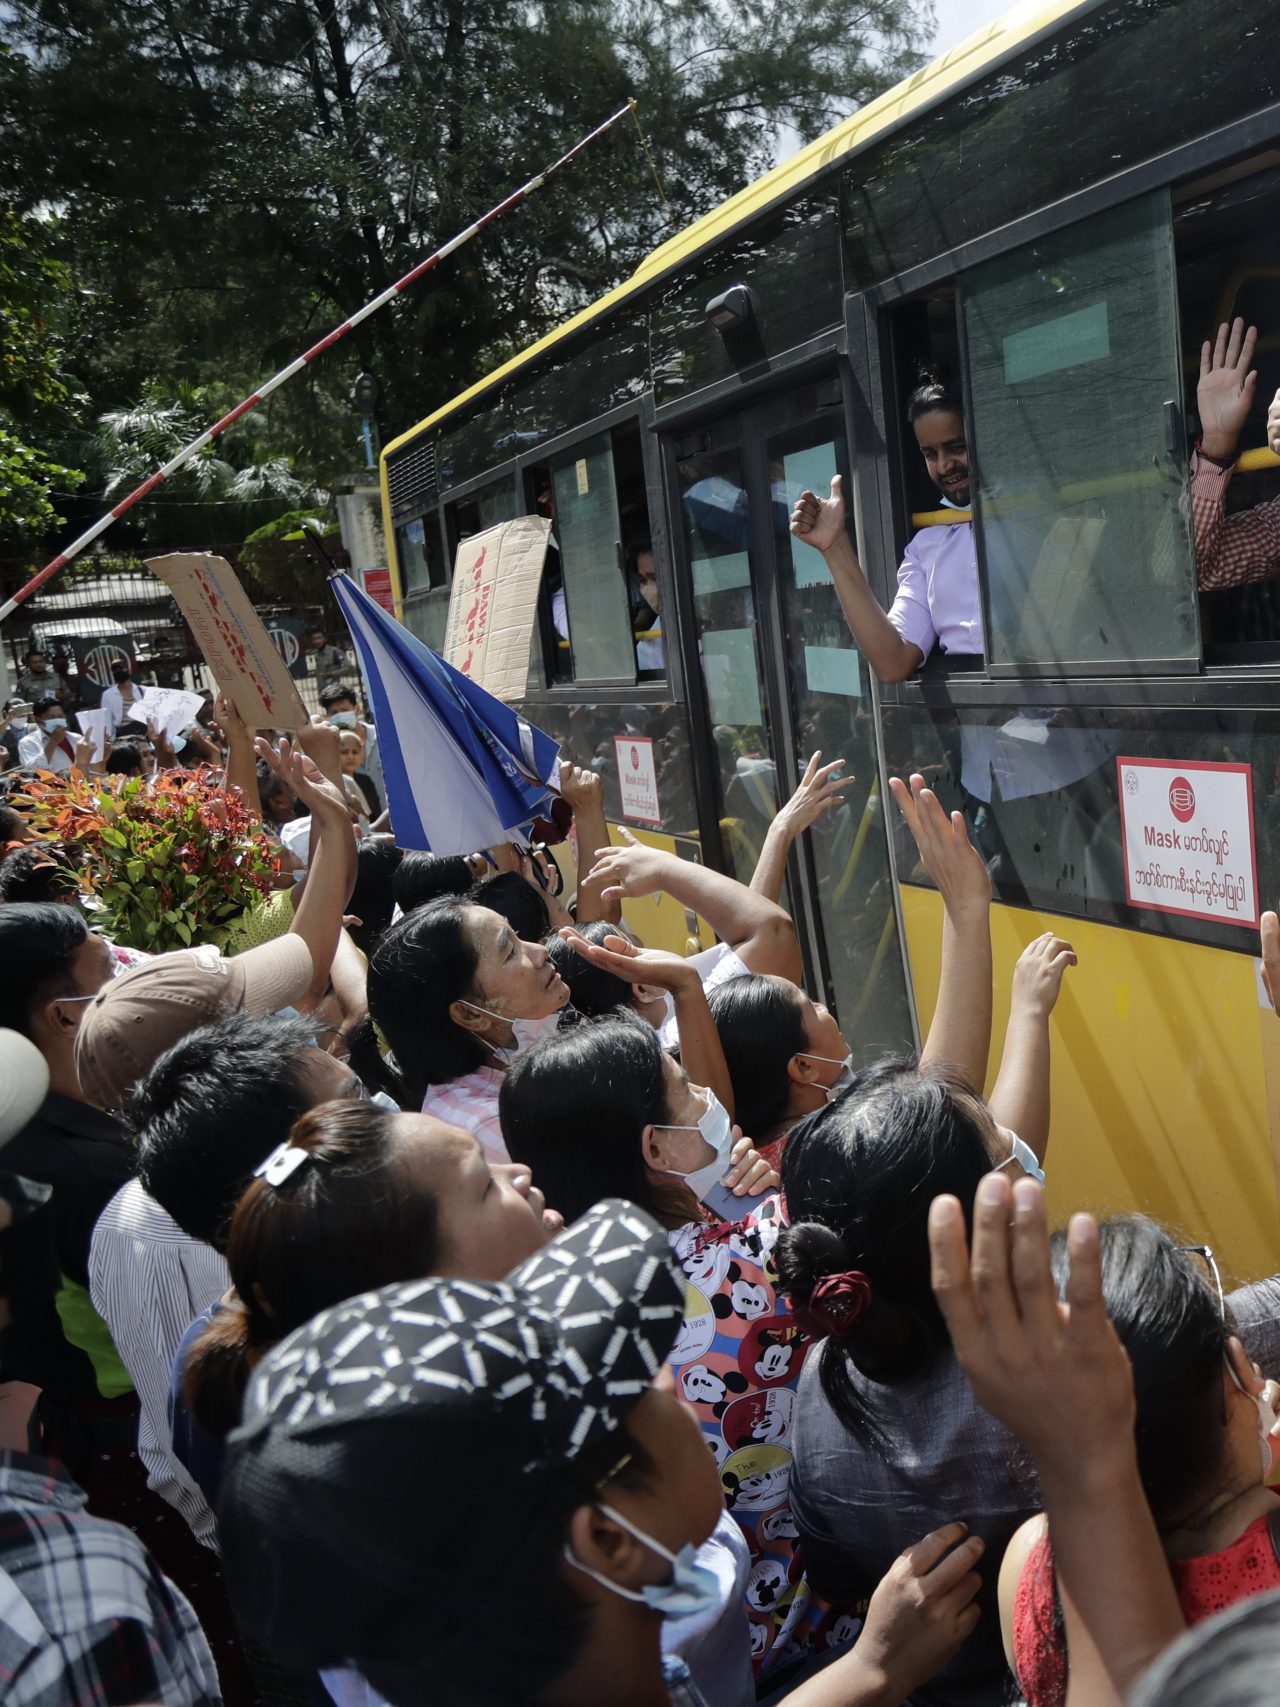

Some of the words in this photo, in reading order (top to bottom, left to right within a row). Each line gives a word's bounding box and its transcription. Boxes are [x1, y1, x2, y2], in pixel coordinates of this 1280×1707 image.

[1144, 826, 1181, 849] Mask
[689, 1317, 708, 1330] 1928
[768, 1391, 777, 1409] 1928
[773, 1466, 791, 1479] 1928
